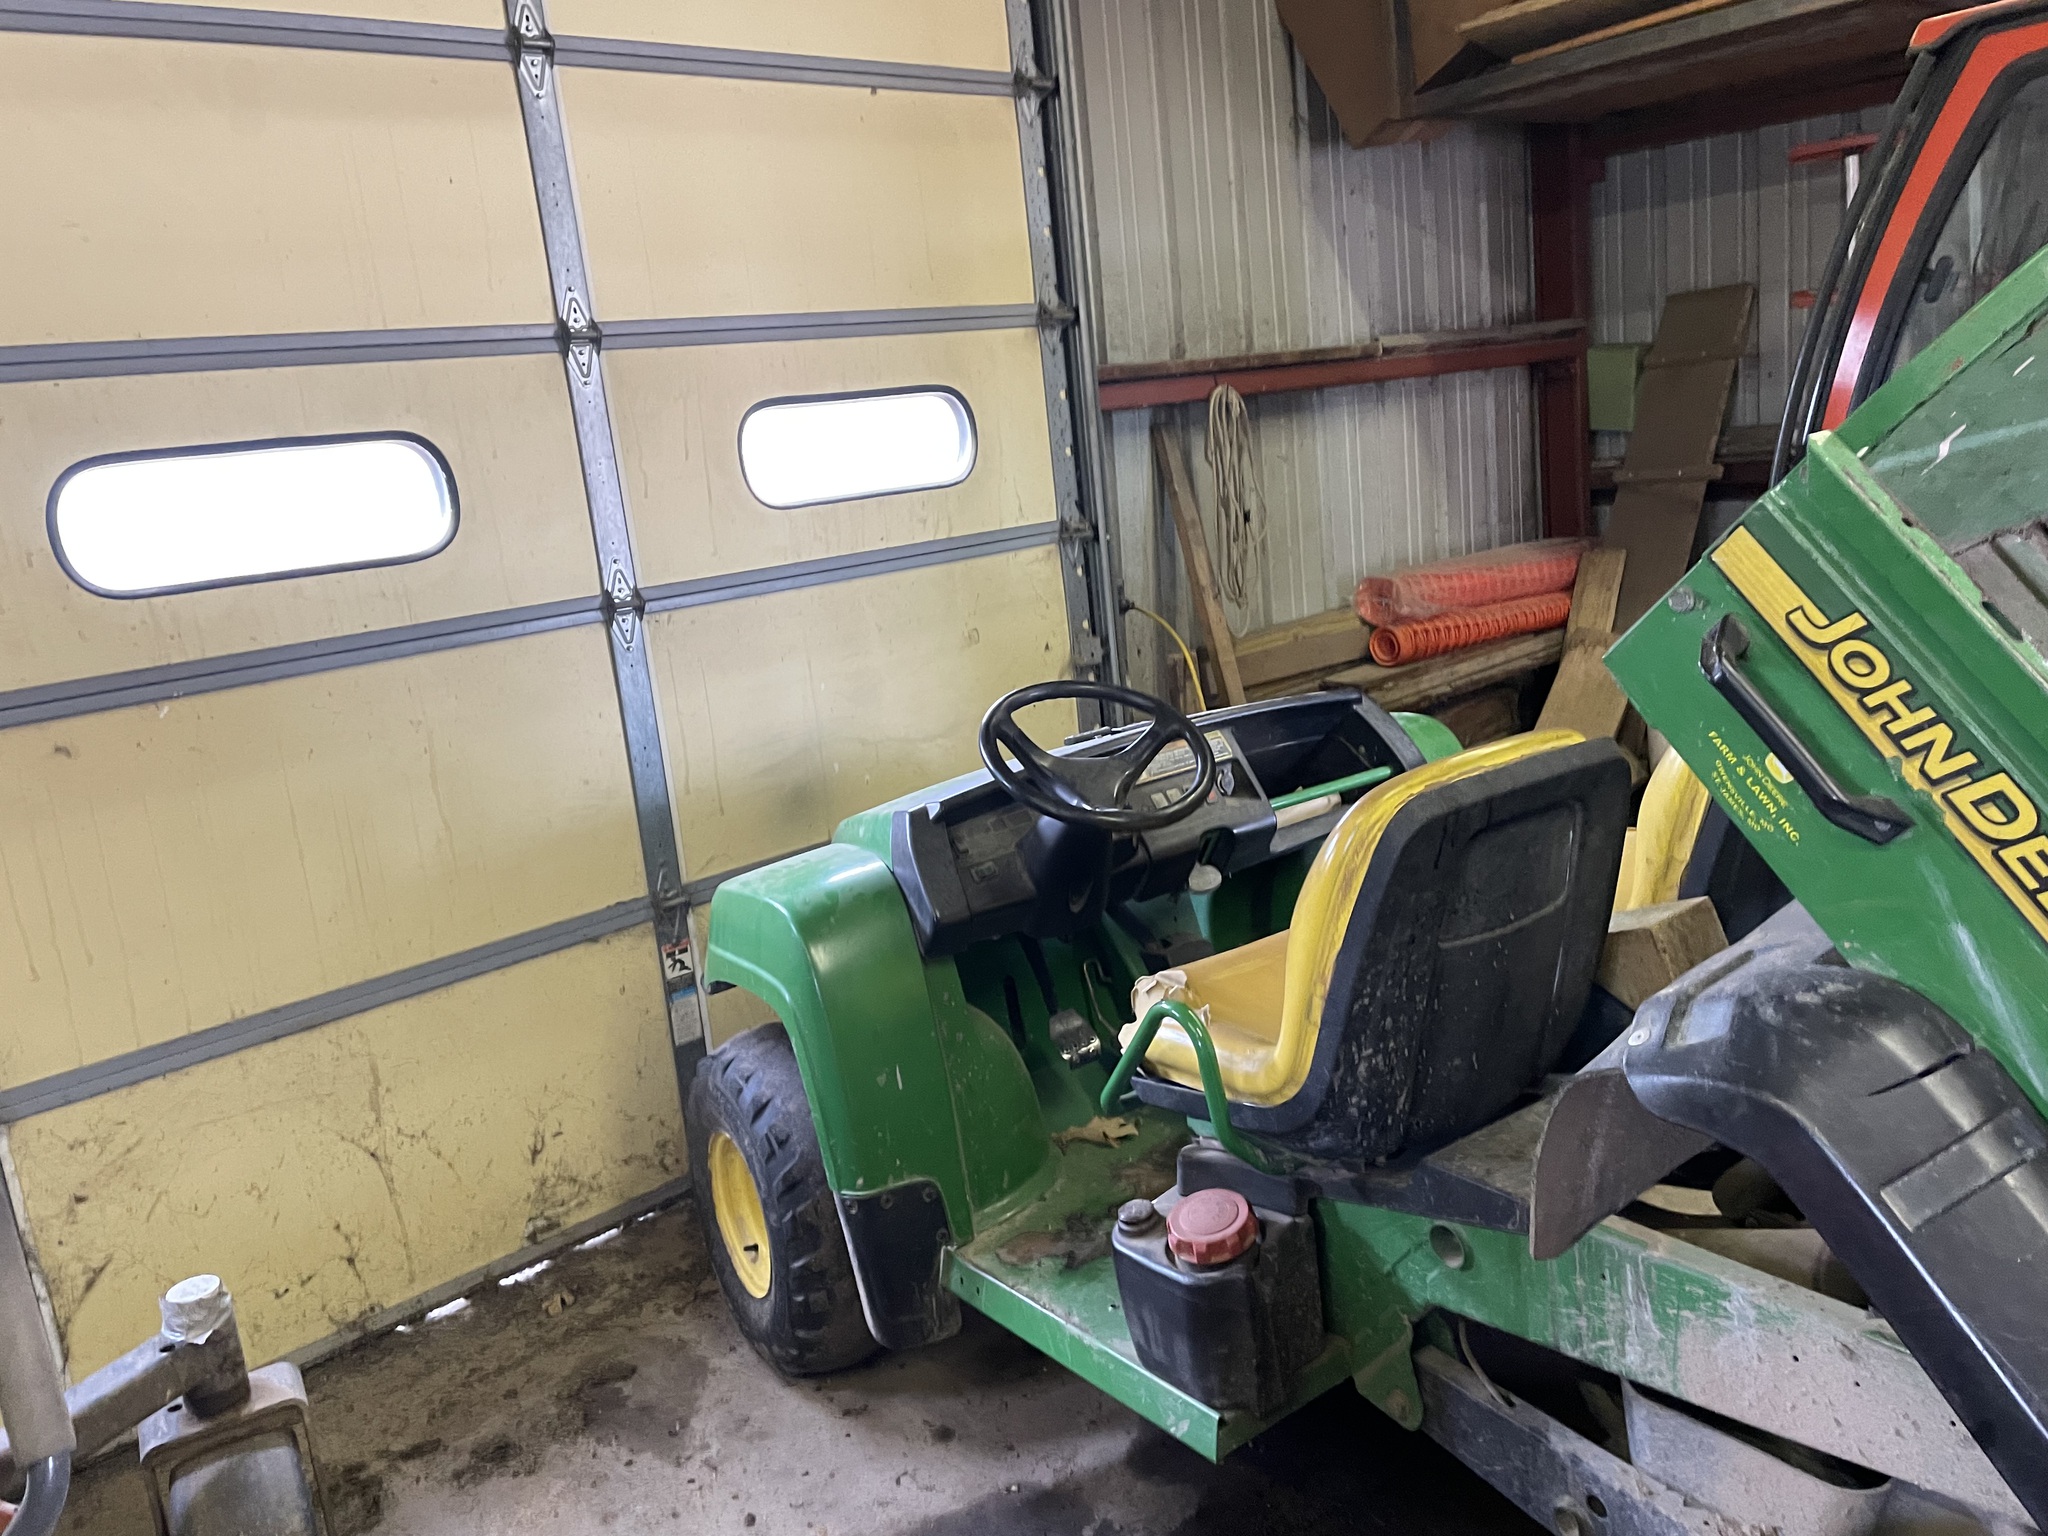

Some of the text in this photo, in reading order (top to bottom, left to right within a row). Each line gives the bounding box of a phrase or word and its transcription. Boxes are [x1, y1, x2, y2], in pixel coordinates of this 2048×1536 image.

[1786, 606, 1981, 785] JOHN
[1708, 731, 1799, 847] FARM & LAWN, INC.
[1742, 754, 1764, 779] JOHN
